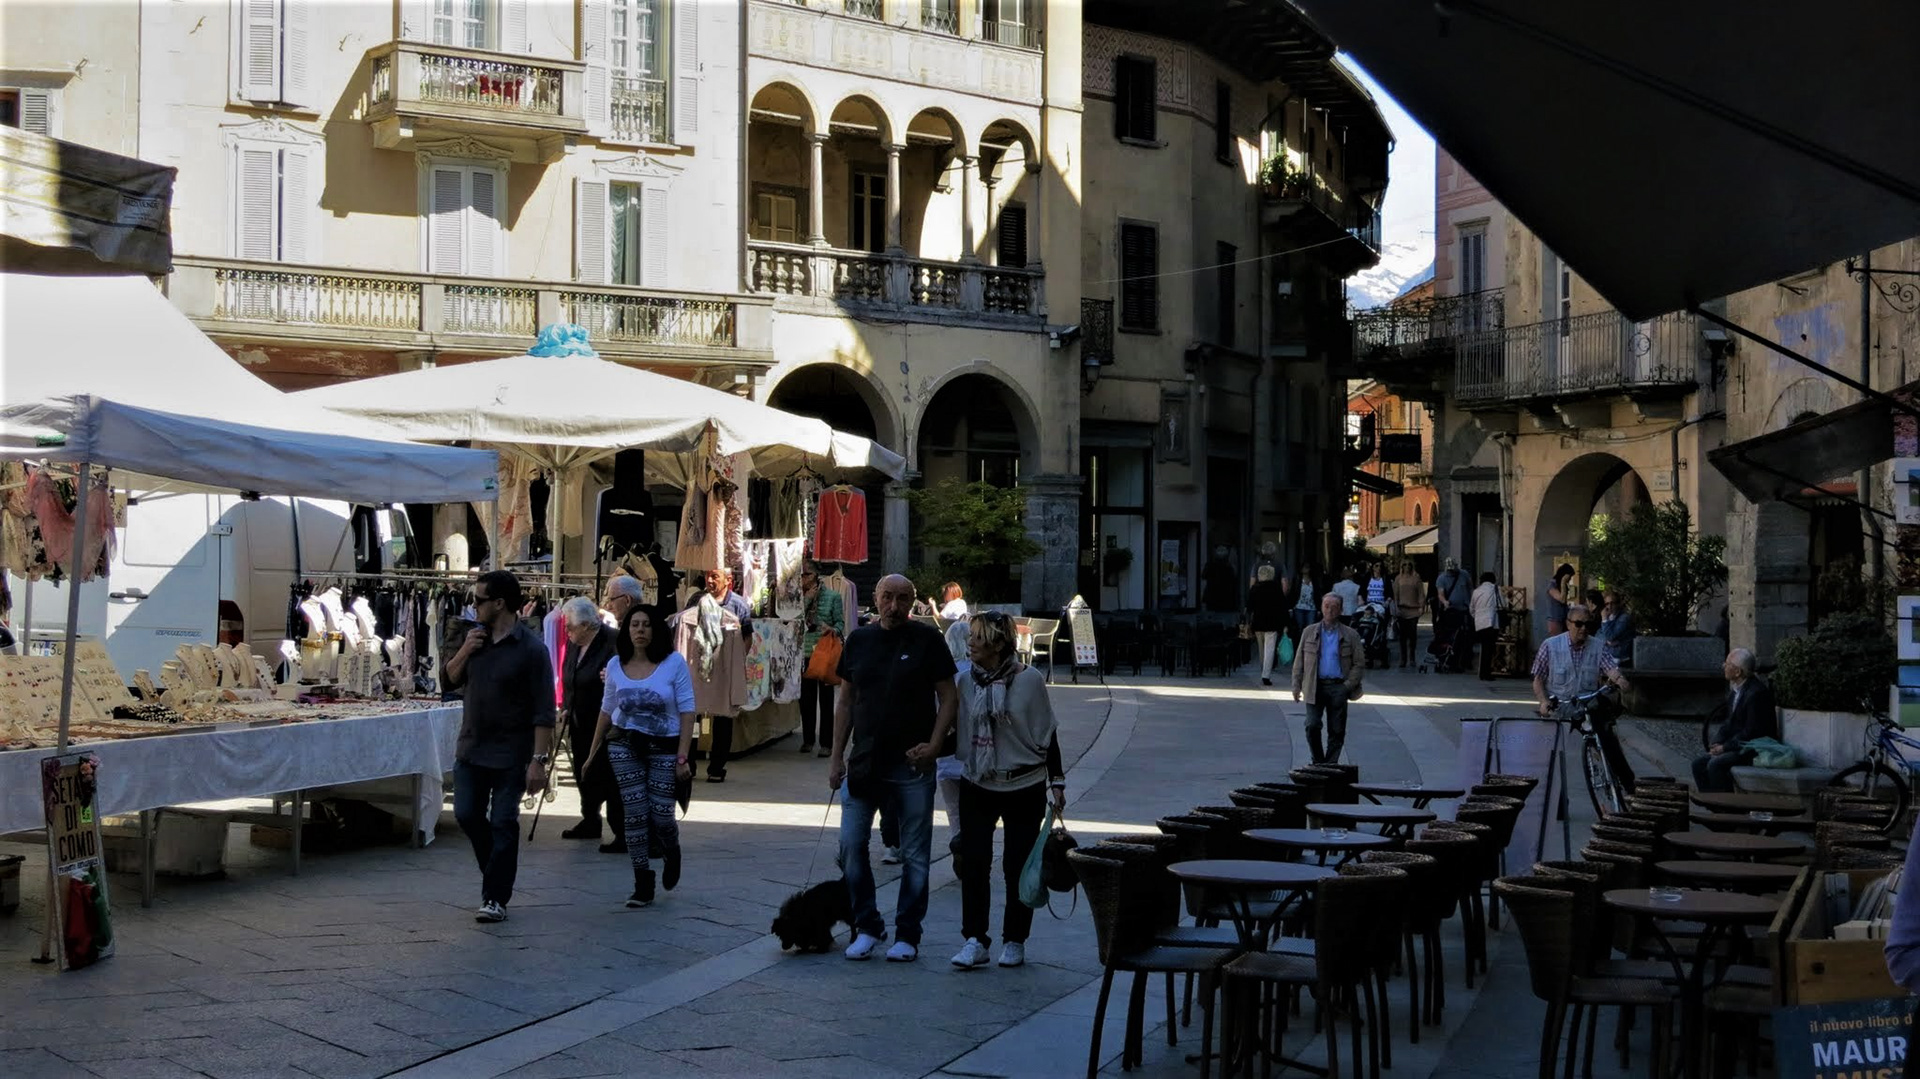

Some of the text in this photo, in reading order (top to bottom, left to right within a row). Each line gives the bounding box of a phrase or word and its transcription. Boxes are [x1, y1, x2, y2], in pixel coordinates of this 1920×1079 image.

[52, 775, 83, 805] SETA
[64, 805, 78, 831] DI
[59, 831, 95, 862] COMO
[1809, 1020, 1818, 1033] il
[1822, 1019, 1863, 1032] nuovo
[1868, 1015, 1900, 1028] libro
